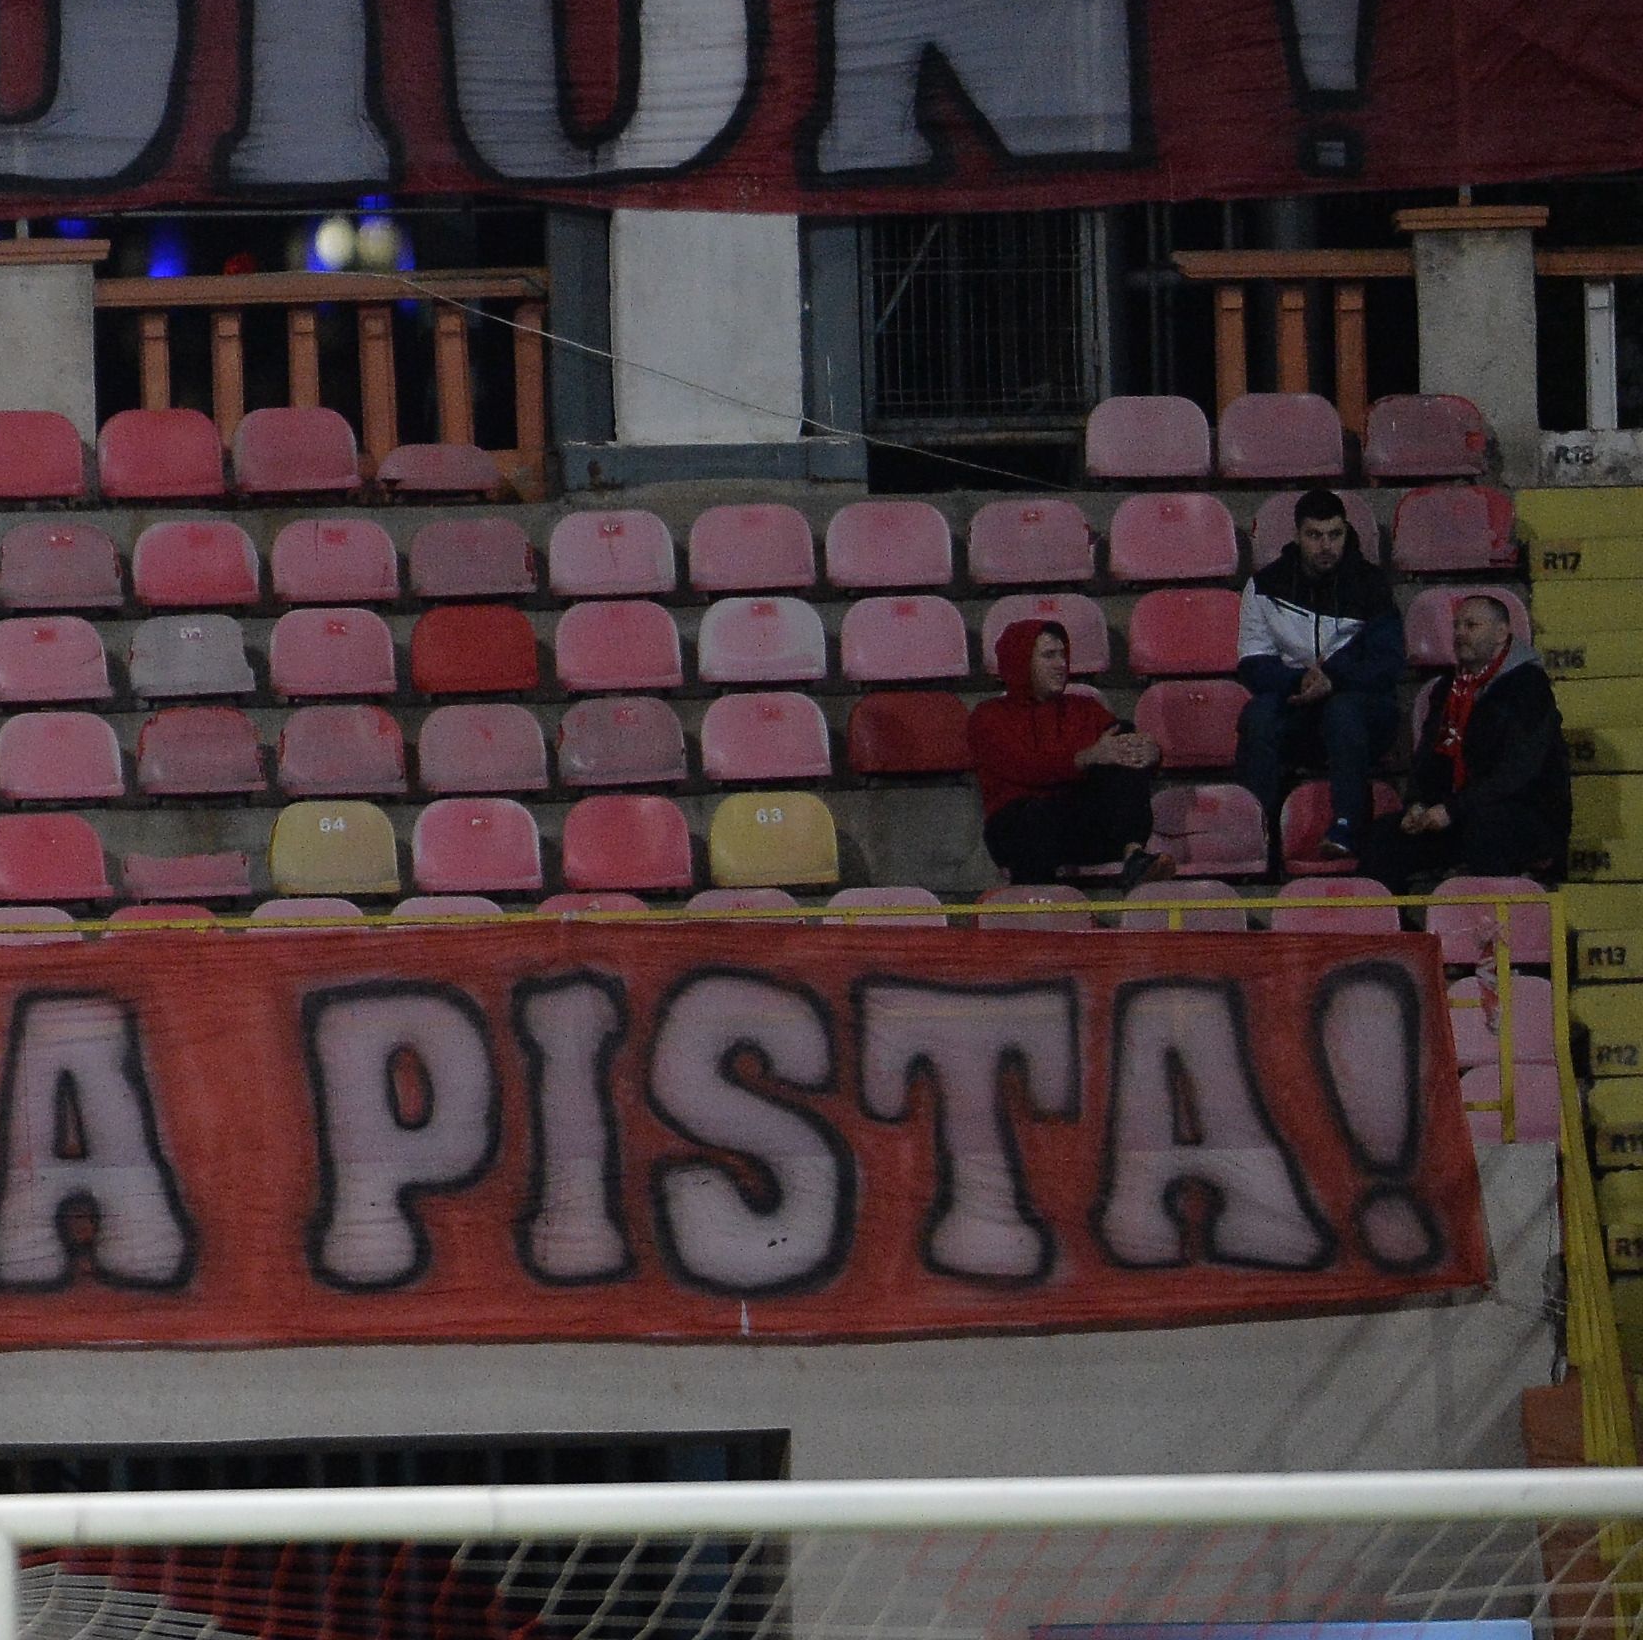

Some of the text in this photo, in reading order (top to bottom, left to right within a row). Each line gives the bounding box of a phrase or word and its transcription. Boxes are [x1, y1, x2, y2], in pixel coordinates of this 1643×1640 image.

[1544, 551, 1581, 573] R17
[755, 807, 784, 824] 63
[1588, 947, 1627, 966] R13
[301, 959, 1446, 1297] PISTA!
